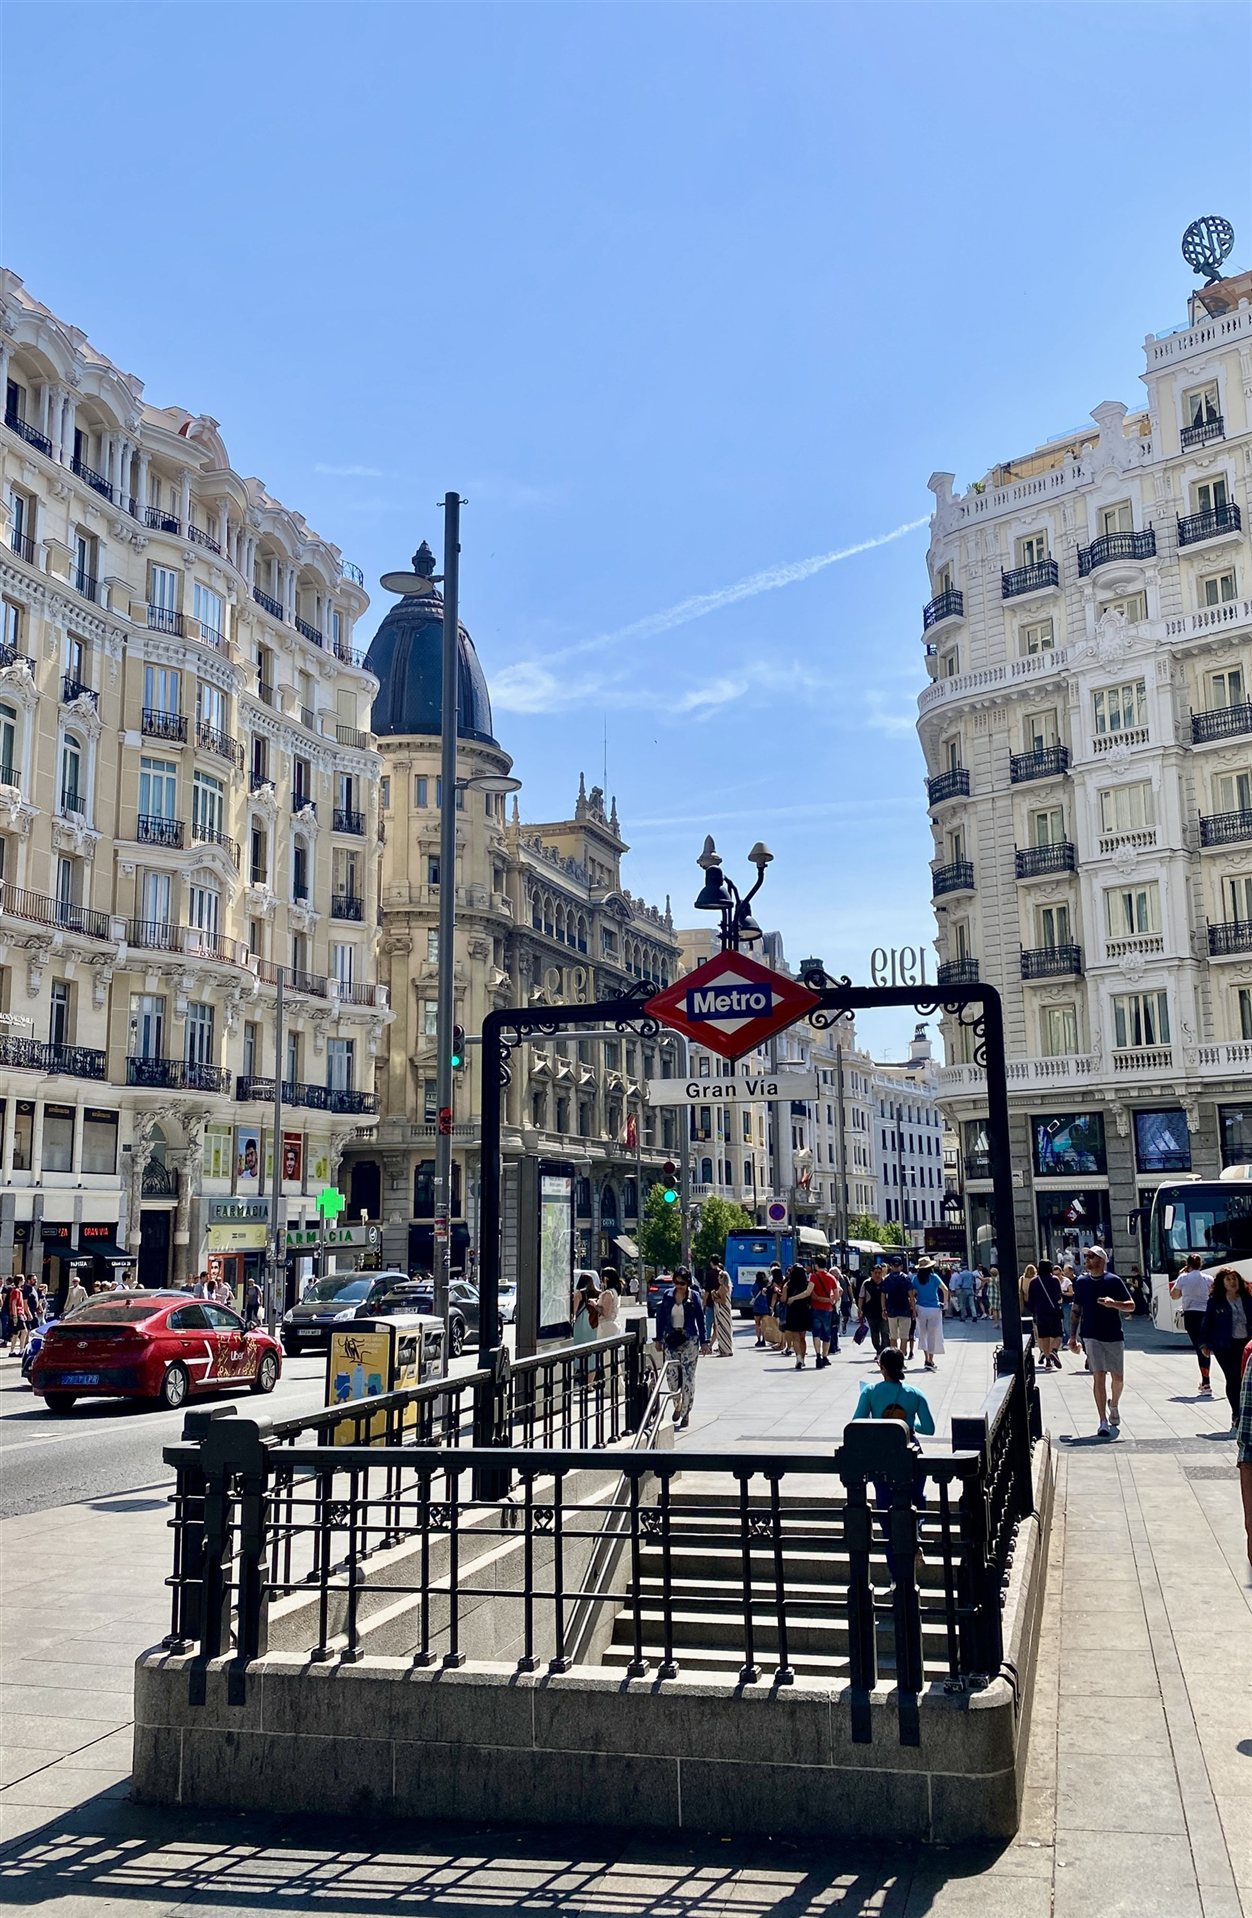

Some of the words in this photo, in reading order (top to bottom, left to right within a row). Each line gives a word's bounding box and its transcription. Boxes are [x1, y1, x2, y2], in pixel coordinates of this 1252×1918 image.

[693, 990, 766, 1014] Metro
[685, 1082, 737, 1099] Gran
[745, 1079, 778, 1096] Vía
[216, 1205, 269, 1217] FARMACIA
[286, 1230, 353, 1244] ARMCIA
[230, 1351, 244, 1361] Uber
